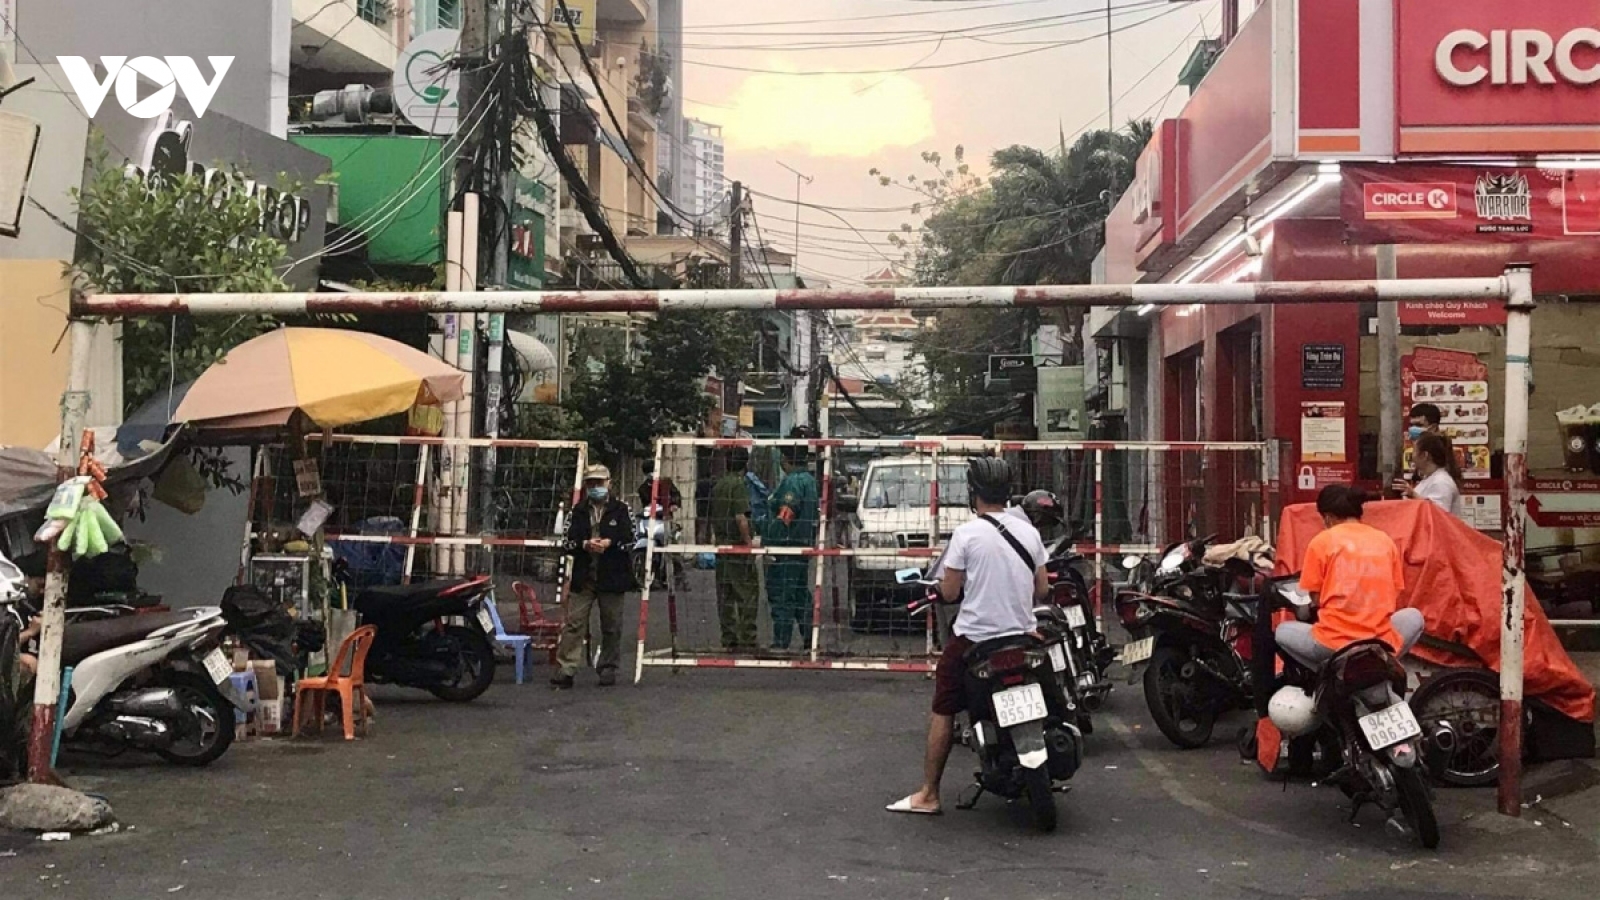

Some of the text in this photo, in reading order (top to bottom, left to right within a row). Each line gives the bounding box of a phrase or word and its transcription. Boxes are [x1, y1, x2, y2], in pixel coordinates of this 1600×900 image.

[1435, 28, 1600, 86] CIRC
[1372, 192, 1424, 205] CIRCLE
[1476, 194, 1531, 220] WARRIOR
